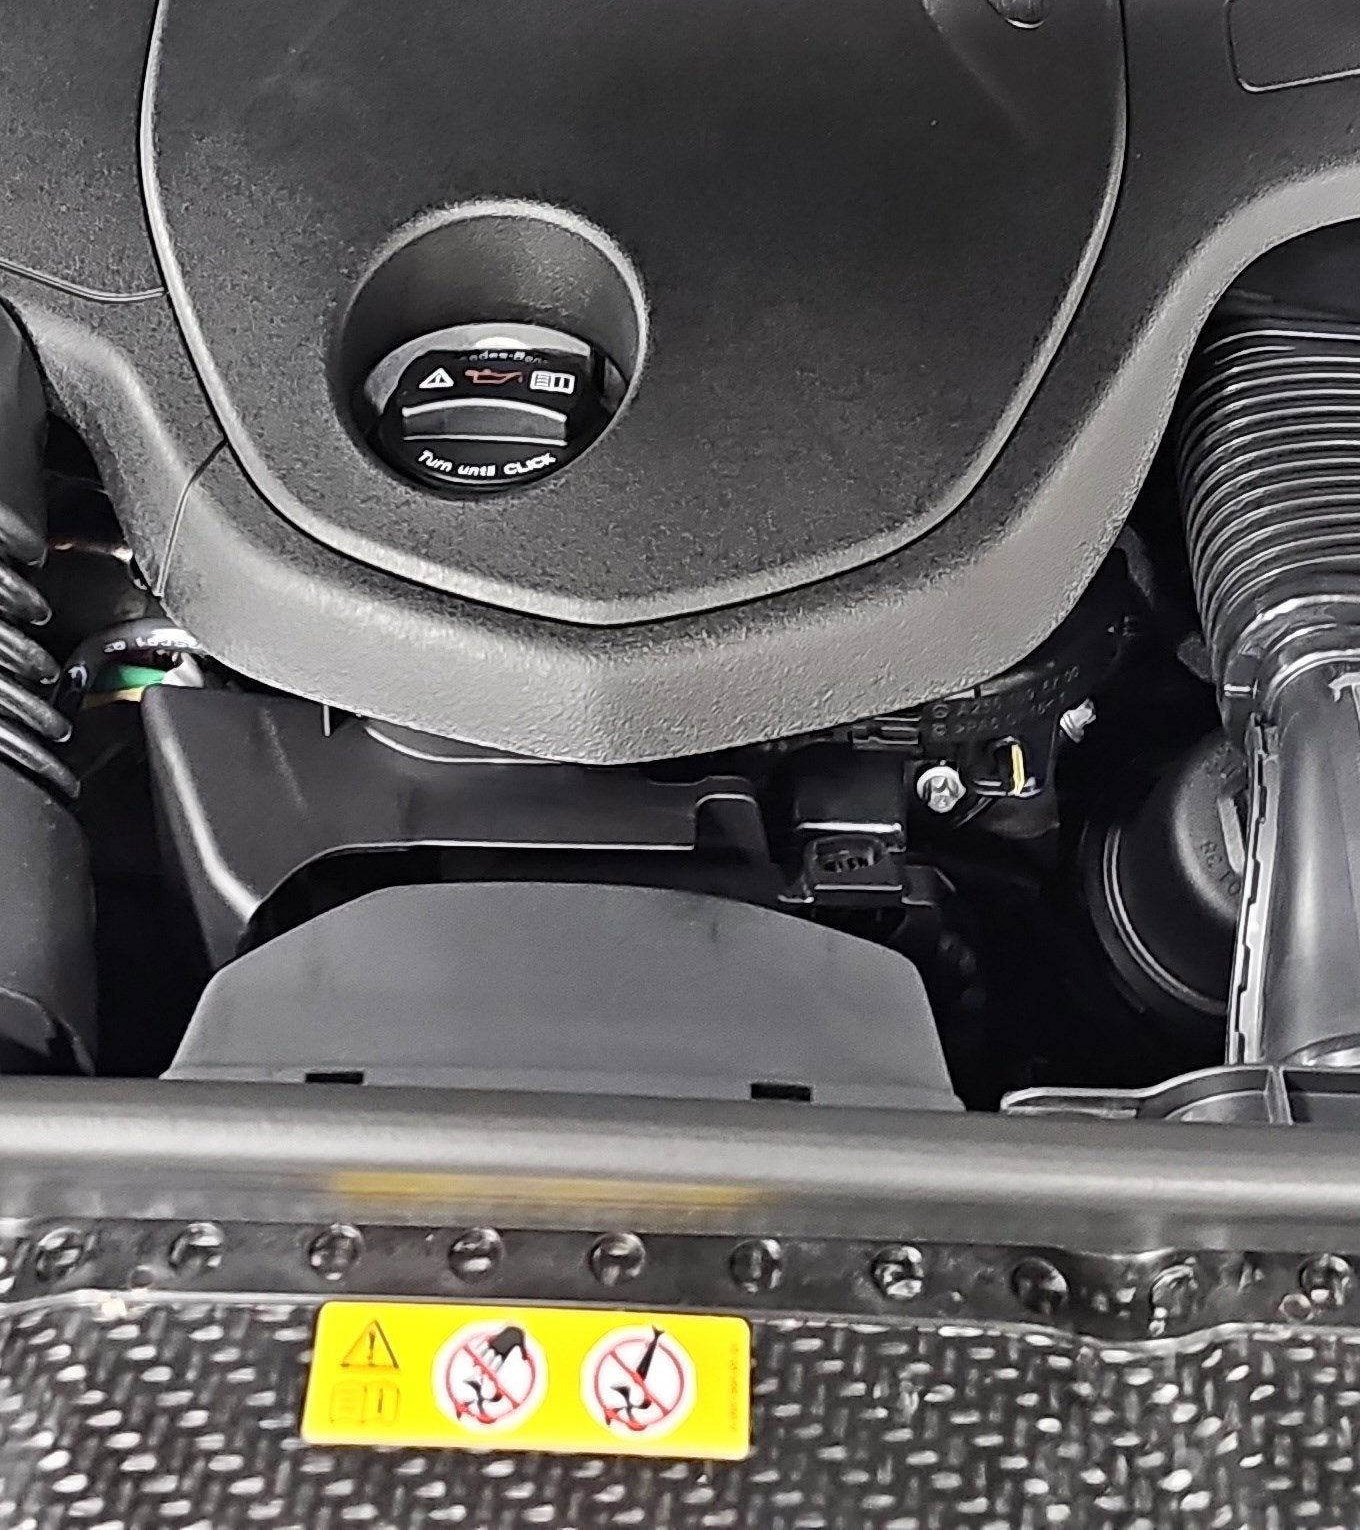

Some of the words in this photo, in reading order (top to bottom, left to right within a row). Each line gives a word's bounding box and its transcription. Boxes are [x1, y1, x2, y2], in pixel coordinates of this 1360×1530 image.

[418, 449, 453, 472] Turn
[457, 464, 496, 477] until
[504, 451, 557, 475] CLICK
